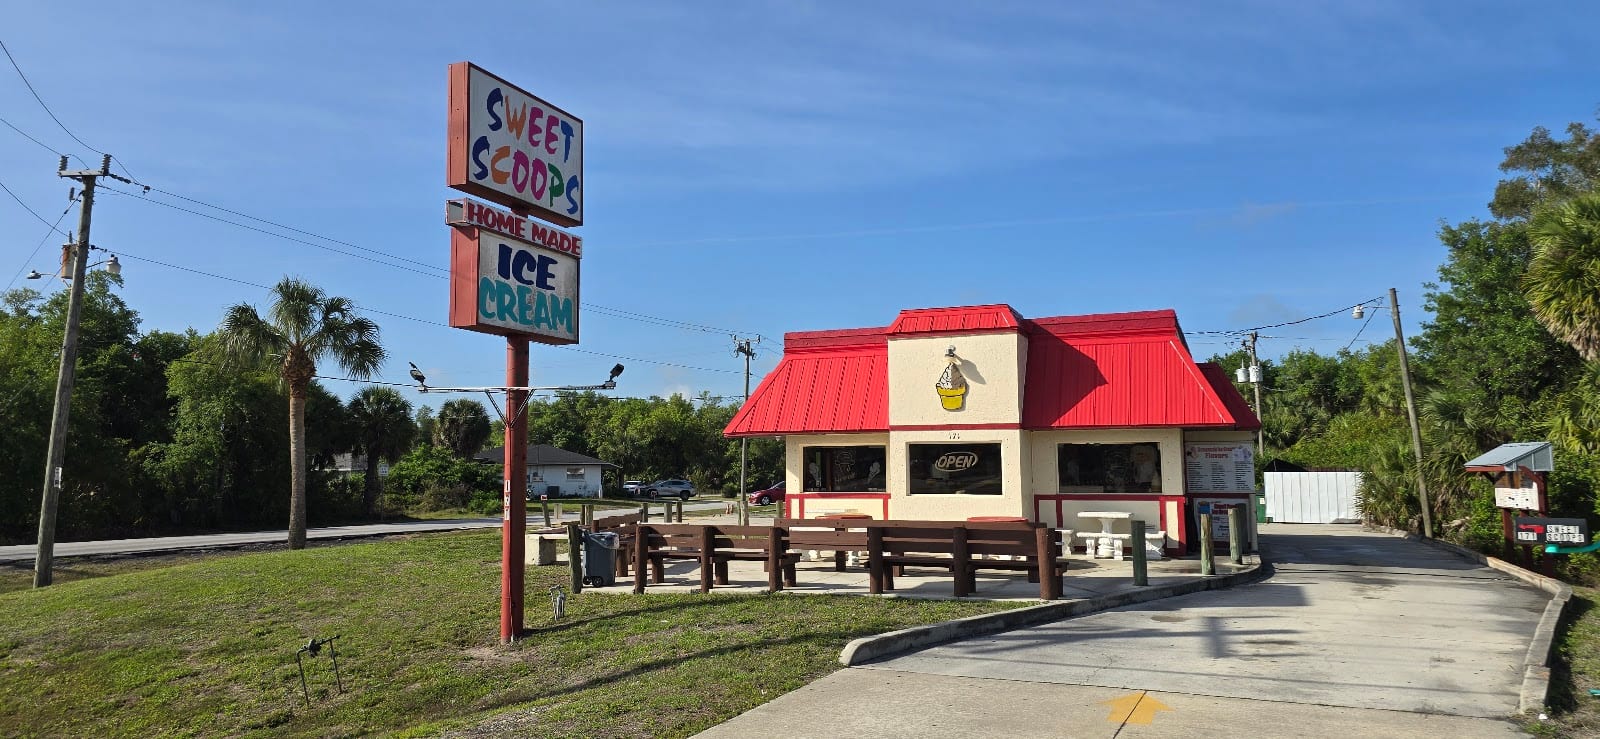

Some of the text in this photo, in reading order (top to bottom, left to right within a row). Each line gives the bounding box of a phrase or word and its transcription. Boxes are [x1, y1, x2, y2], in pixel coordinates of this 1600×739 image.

[487, 87, 574, 163] SWEET
[472, 135, 579, 215] SCOOPS
[467, 202, 582, 256] HOME MADE
[498, 243, 558, 291] ICE
[479, 276, 574, 334] CREAM
[937, 455, 974, 468] OPEN
[1519, 532, 1536, 540] 171
